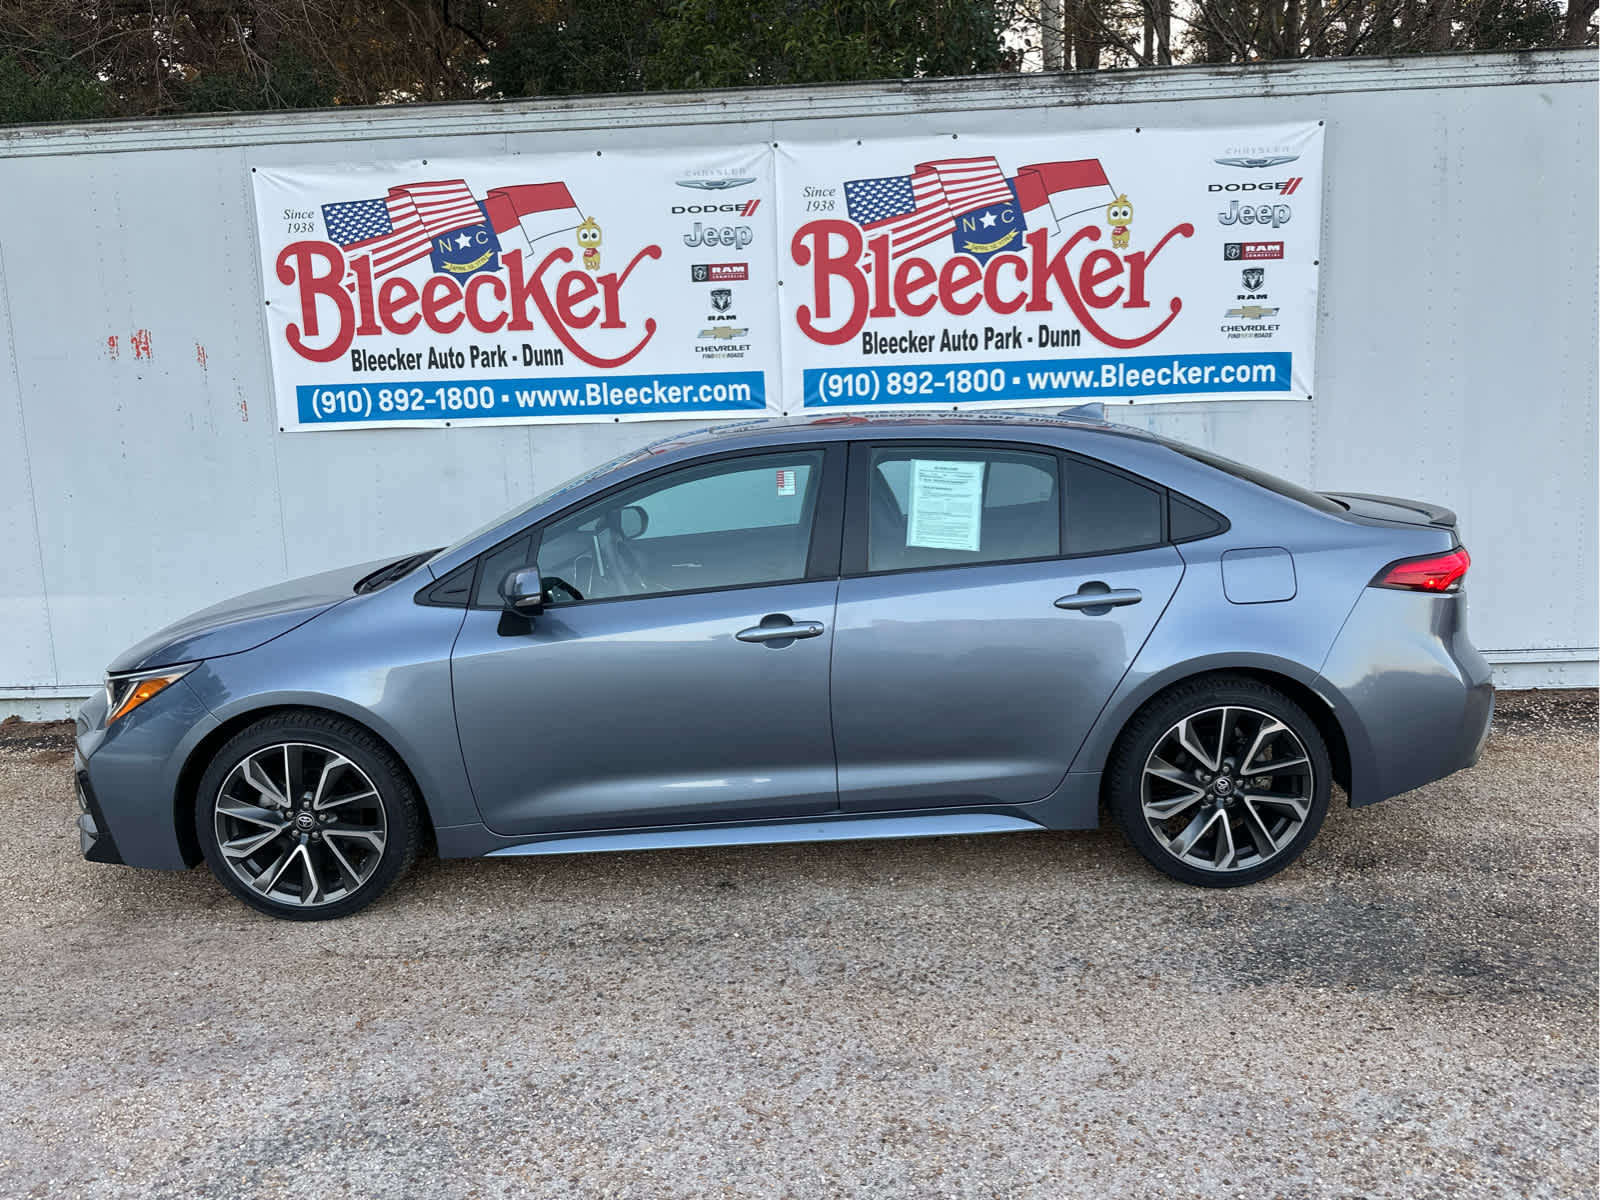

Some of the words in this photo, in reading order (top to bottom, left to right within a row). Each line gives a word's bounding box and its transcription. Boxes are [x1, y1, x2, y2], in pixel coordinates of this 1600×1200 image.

[803, 186, 836, 198] Since
[1208, 181, 1289, 192] DODGE
[283, 208, 315, 221] Since
[671, 203, 749, 214] DODGE
[805, 199, 836, 212] 1938
[1217, 200, 1291, 229] Jeep
[287, 222, 315, 234] 1938
[682, 221, 753, 250] Jeep
[790, 219, 1195, 349] Bleecker
[275, 240, 663, 369] Bleecker
[1220, 324, 1280, 332] CHEVROLET
[695, 344, 752, 352] CHEVROLET
[862, 329, 935, 355] Bleecker
[939, 328, 978, 352] Auto
[983, 325, 1023, 350] Park
[1038, 323, 1081, 348] Dunn
[351, 347, 422, 372] Bleecker
[428, 346, 465, 370] Auto
[469, 344, 508, 369] Park
[522, 343, 564, 367] Dunn
[818, 370, 881, 403] (910)
[886, 367, 1006, 395] 892-1800
[1027, 359, 1277, 391] www.Bleecker.com
[312, 387, 372, 419] (910)
[378, 385, 495, 411] 892-1800
[515, 379, 751, 408] www.Bleecker.com
